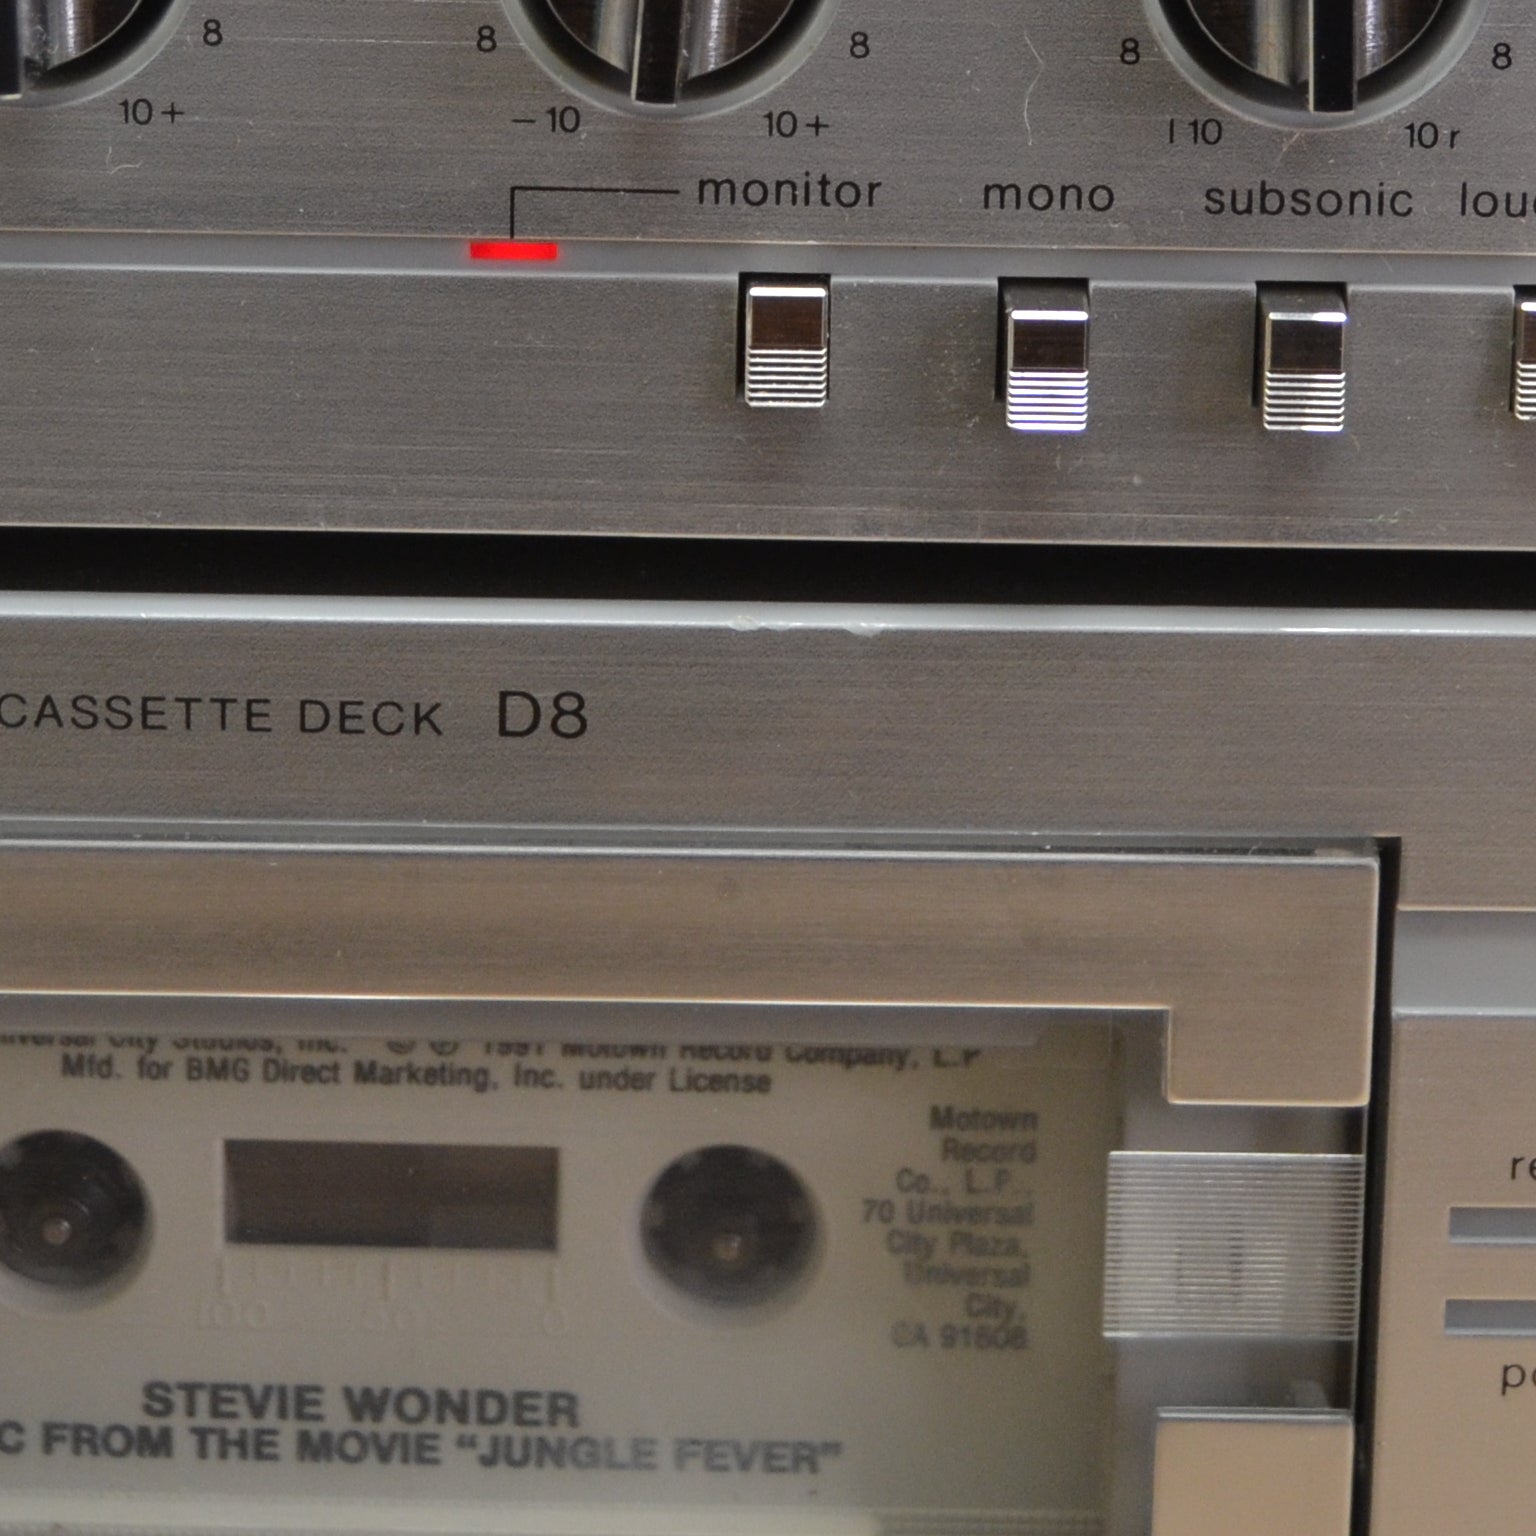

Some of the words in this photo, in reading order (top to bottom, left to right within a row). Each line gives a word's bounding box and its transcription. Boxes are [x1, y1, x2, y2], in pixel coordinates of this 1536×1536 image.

[202, 18, 224, 47] 8
[476, 24, 498, 54] 8
[849, 30, 871, 60] 8
[1119, 36, 1141, 66] 8
[1491, 42, 1513, 71] 8
[1188, 117, 1224, 146] 10
[1405, 121, 1439, 150] 10
[697, 171, 882, 209] monitor
[983, 183, 1115, 213] mono
[1204, 179, 1413, 218] subsonic
[299, 699, 443, 737] DECK
[498, 690, 588, 740] D8
[136, 1055, 172, 1082] for
[186, 1056, 250, 1083] BMG
[263, 1057, 340, 1085] Direct
[578, 1068, 656, 1092] under
[669, 1066, 772, 1093] License
[142, 1380, 325, 1422] STEVIE
[343, 1387, 580, 1428] WONDER
[41, 1420, 175, 1460] FROM
[191, 1427, 281, 1462] THE
[295, 1428, 442, 1465] MOVIE
